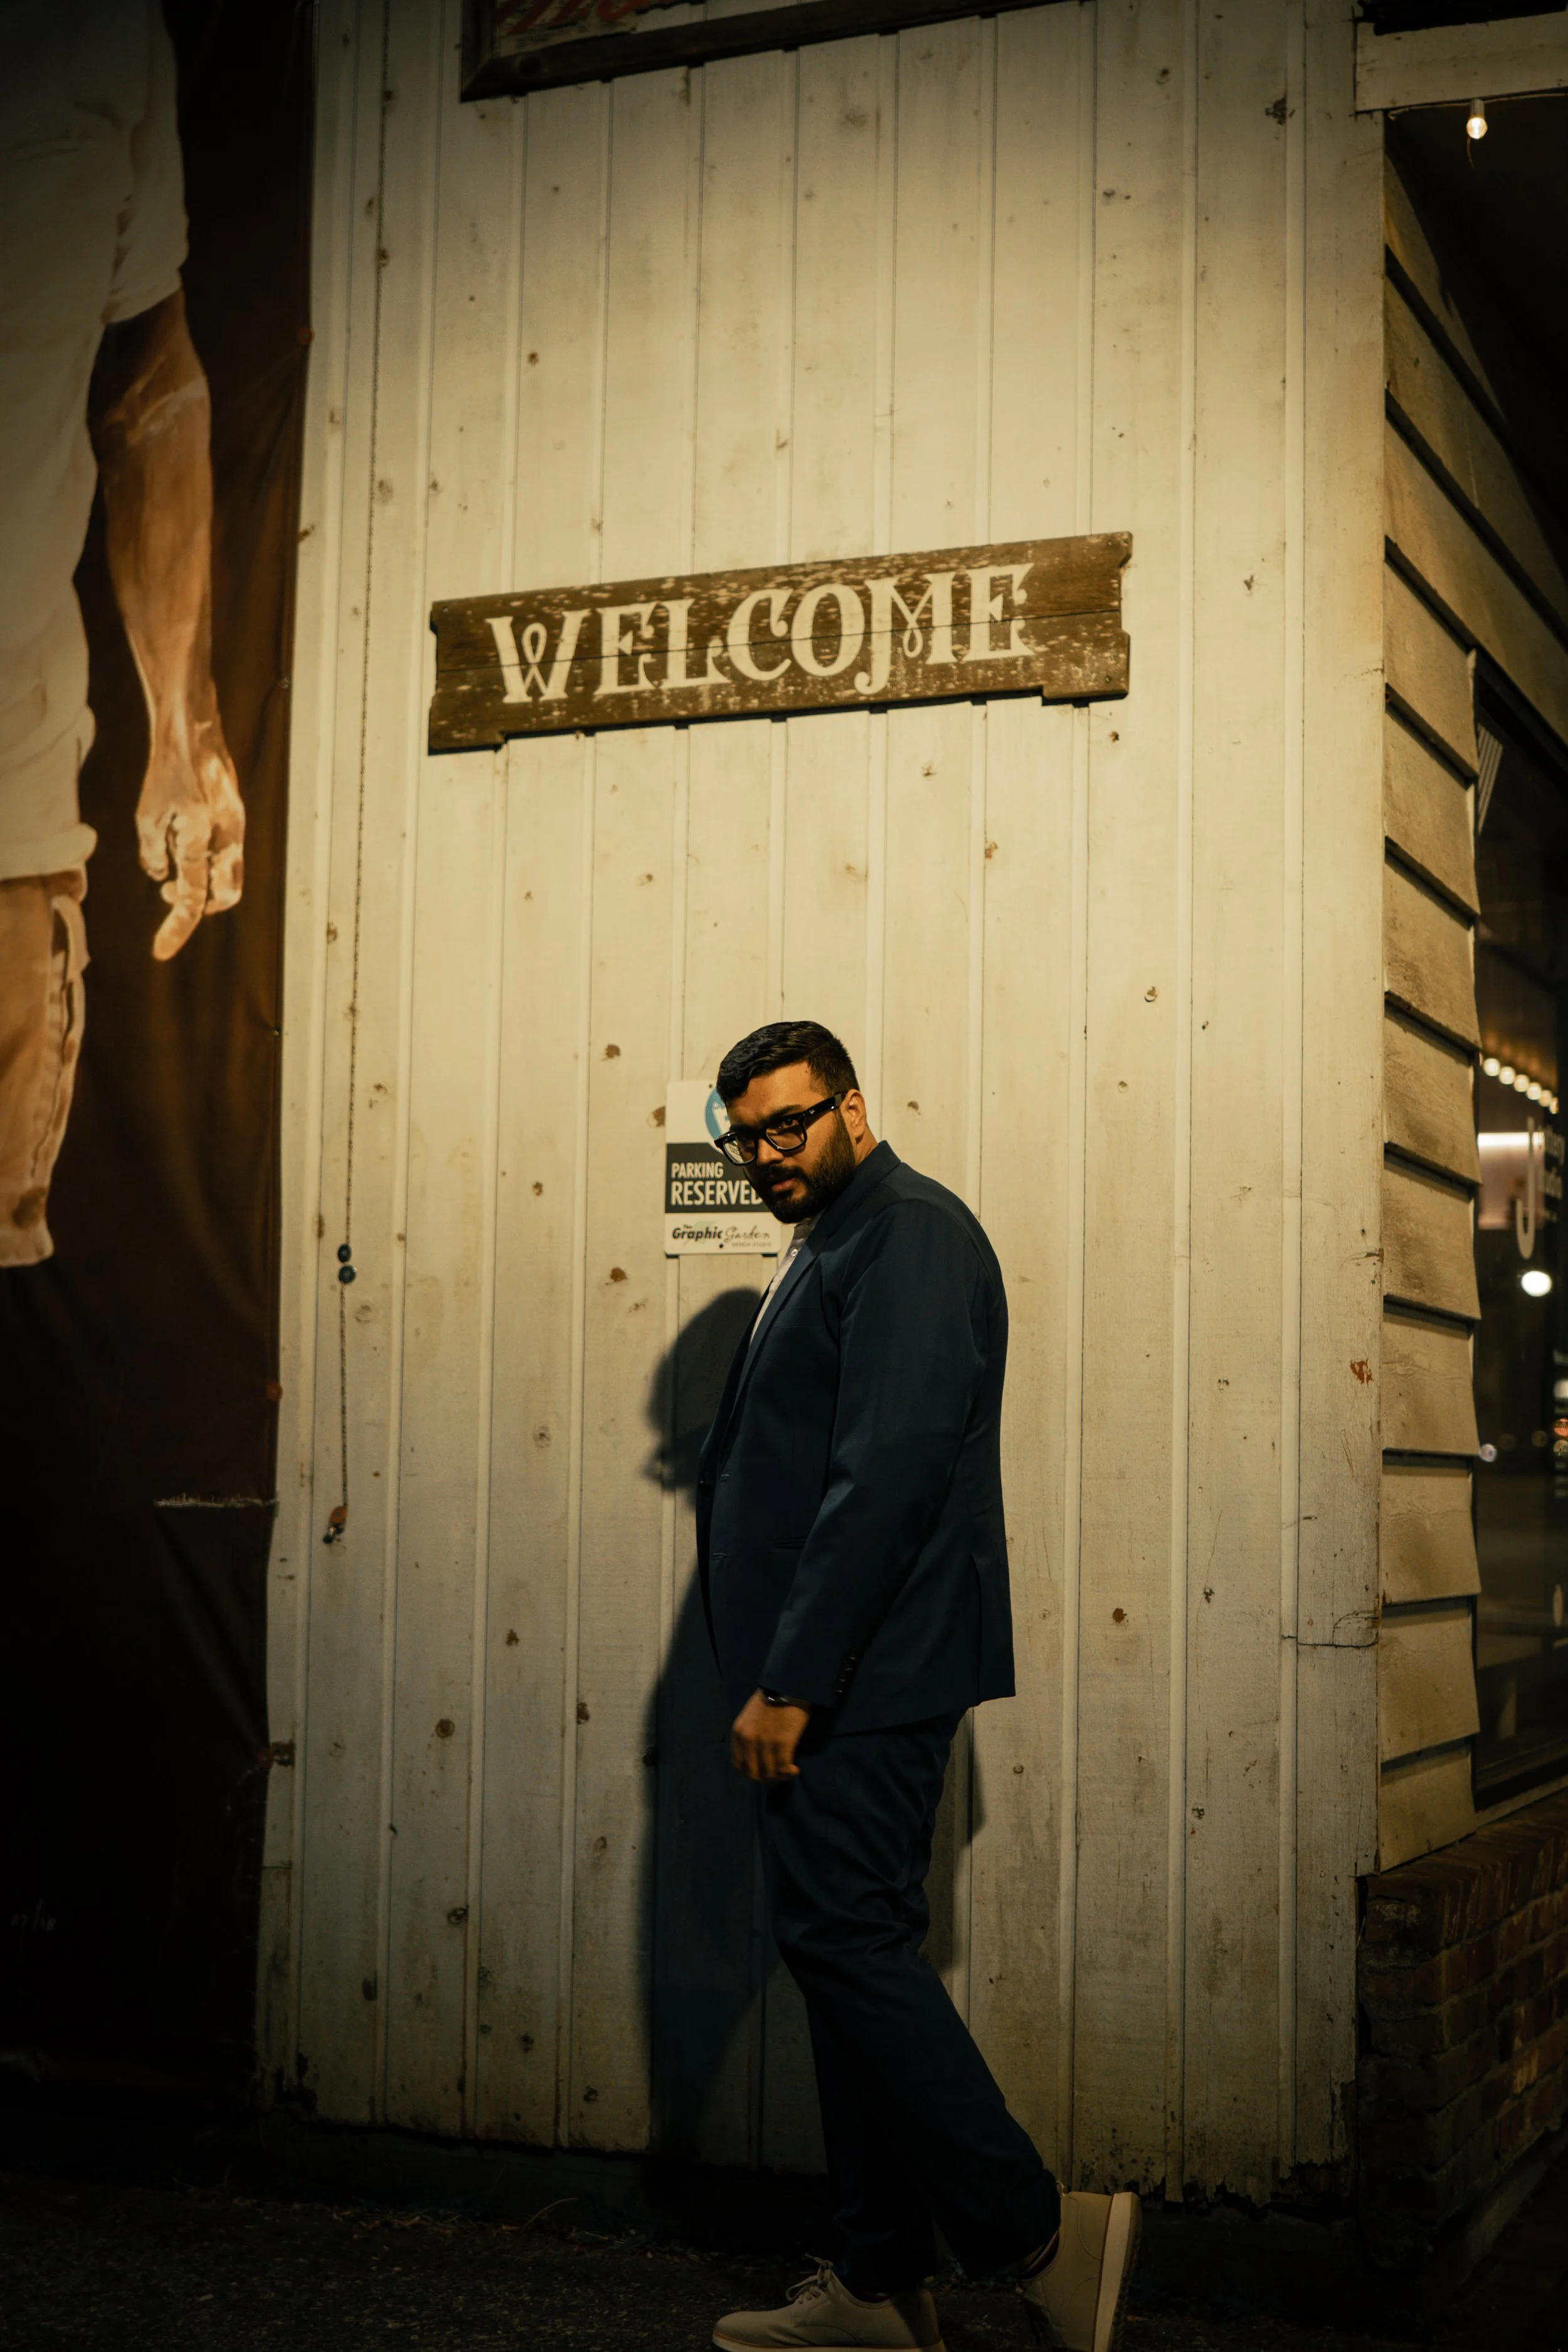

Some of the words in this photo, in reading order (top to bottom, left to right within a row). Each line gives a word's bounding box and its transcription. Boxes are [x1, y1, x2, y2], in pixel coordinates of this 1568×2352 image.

[484, 562, 1035, 704] WELCOME
[671, 1162, 724, 1179] PARKING
[672, 1226, 723, 1242] Graphic
